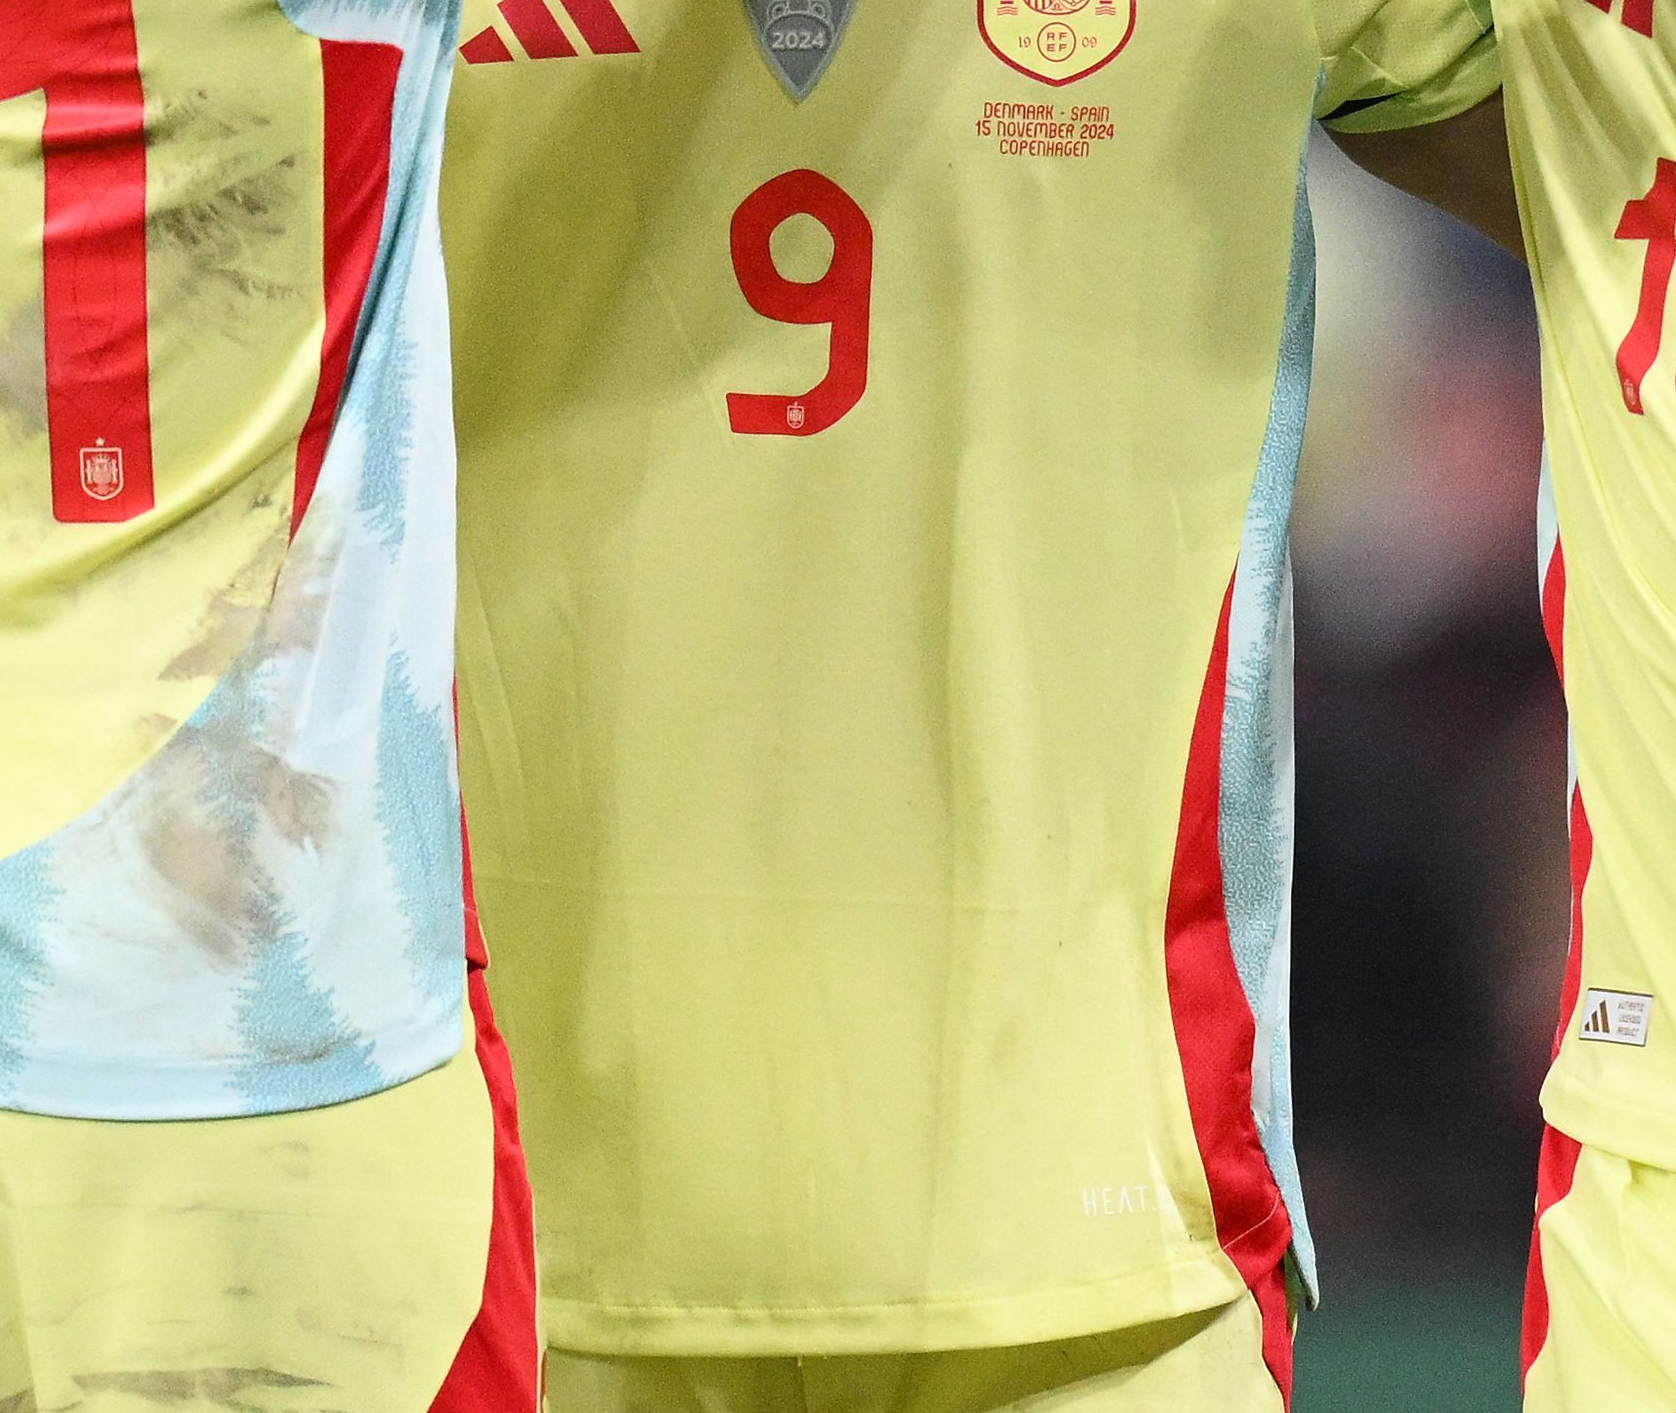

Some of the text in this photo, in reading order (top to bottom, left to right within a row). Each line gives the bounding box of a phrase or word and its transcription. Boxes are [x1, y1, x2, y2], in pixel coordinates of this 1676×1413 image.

[772, 32, 824, 49] 2024
[983, 102, 1054, 120] DENMARK
[1070, 106, 1110, 122] SPAIN
[975, 120, 1115, 140] 15 NOVEMBER 2024
[999, 139, 1090, 157] COPENHAGEN
[726, 169, 874, 437] 9
